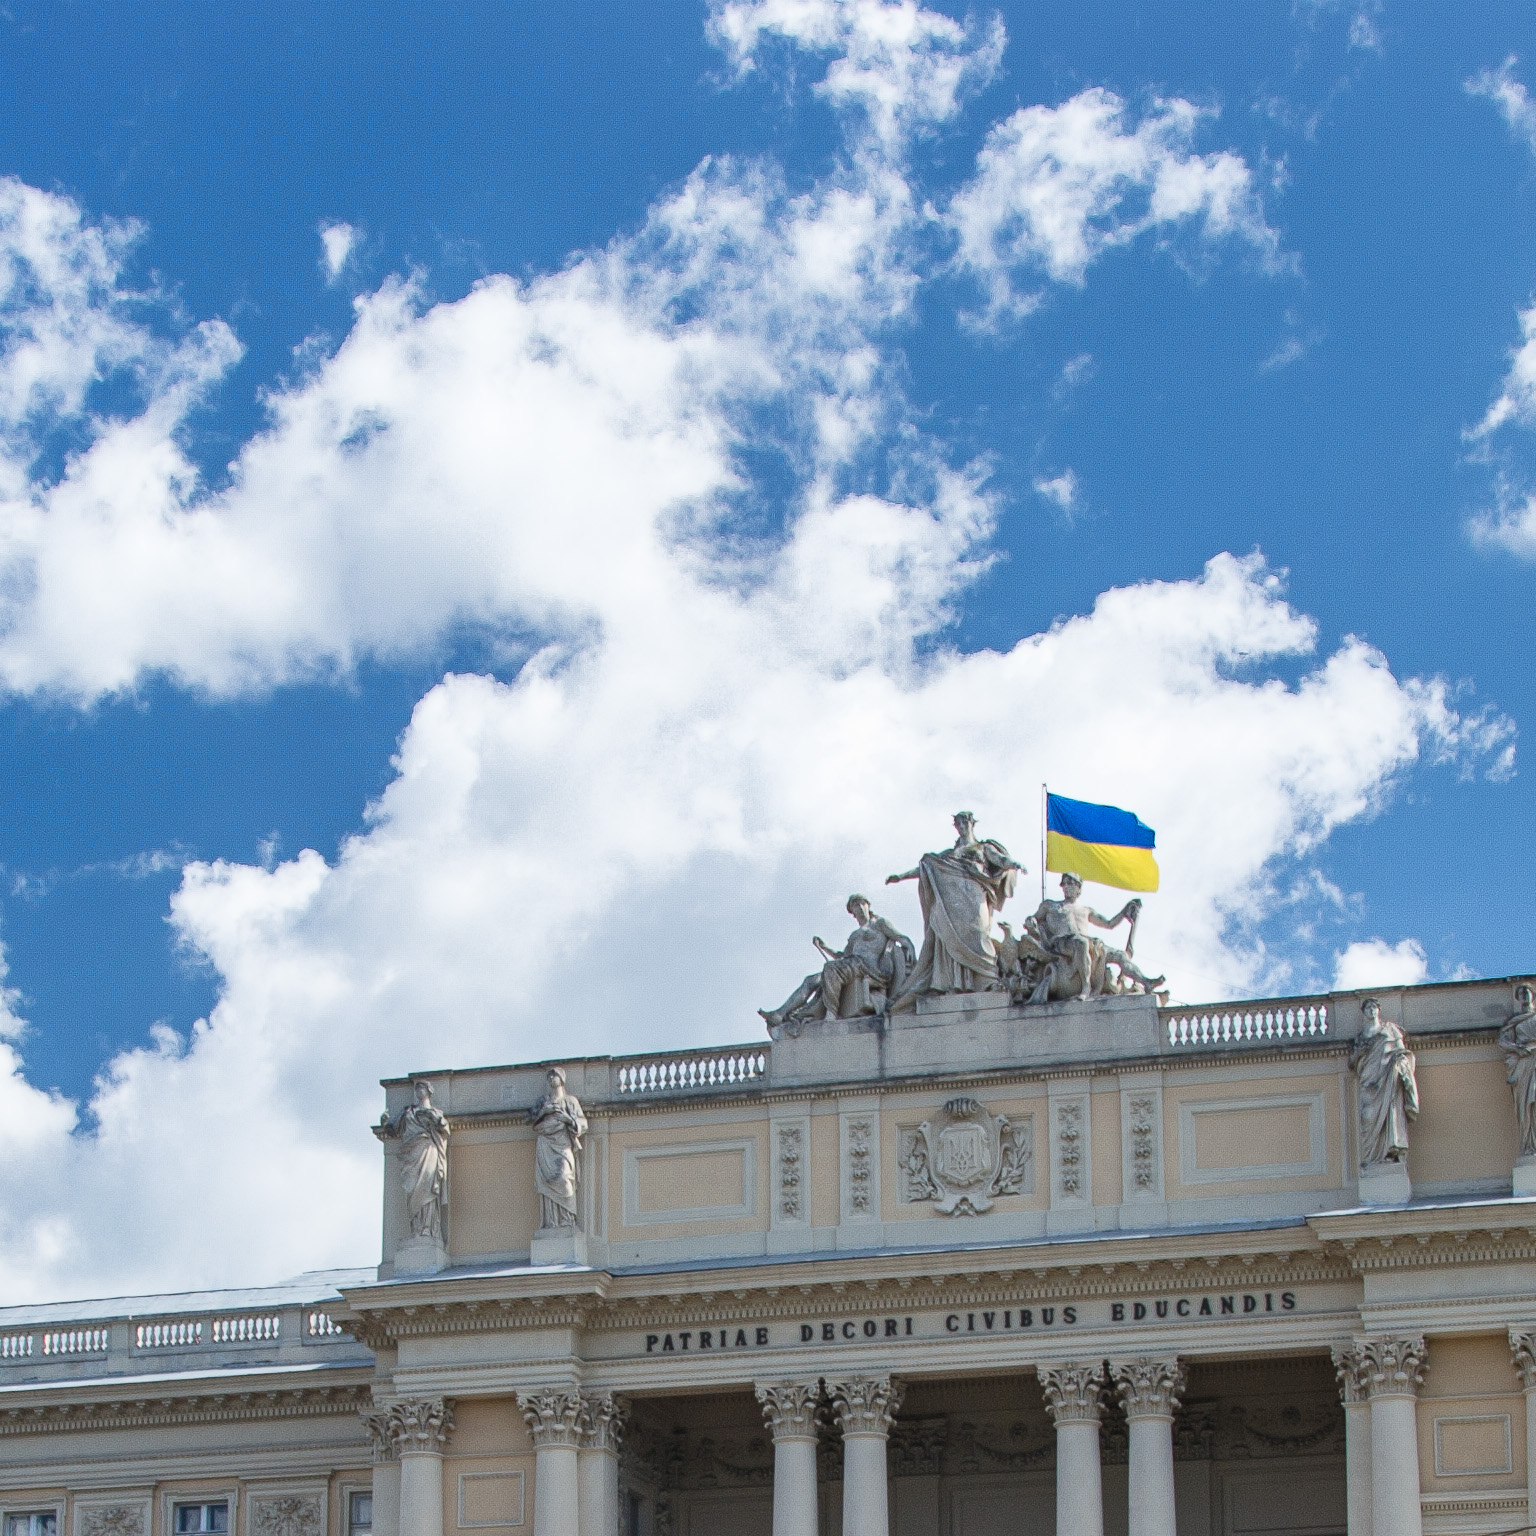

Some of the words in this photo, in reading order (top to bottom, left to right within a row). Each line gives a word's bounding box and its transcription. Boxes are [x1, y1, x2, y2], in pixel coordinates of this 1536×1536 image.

[645, 1327, 770, 1353] PATRIAE
[800, 1316, 914, 1343] DECORI
[945, 1306, 1078, 1333] CIVIBUS
[1110, 1291, 1298, 1323] EDUCANDIS
